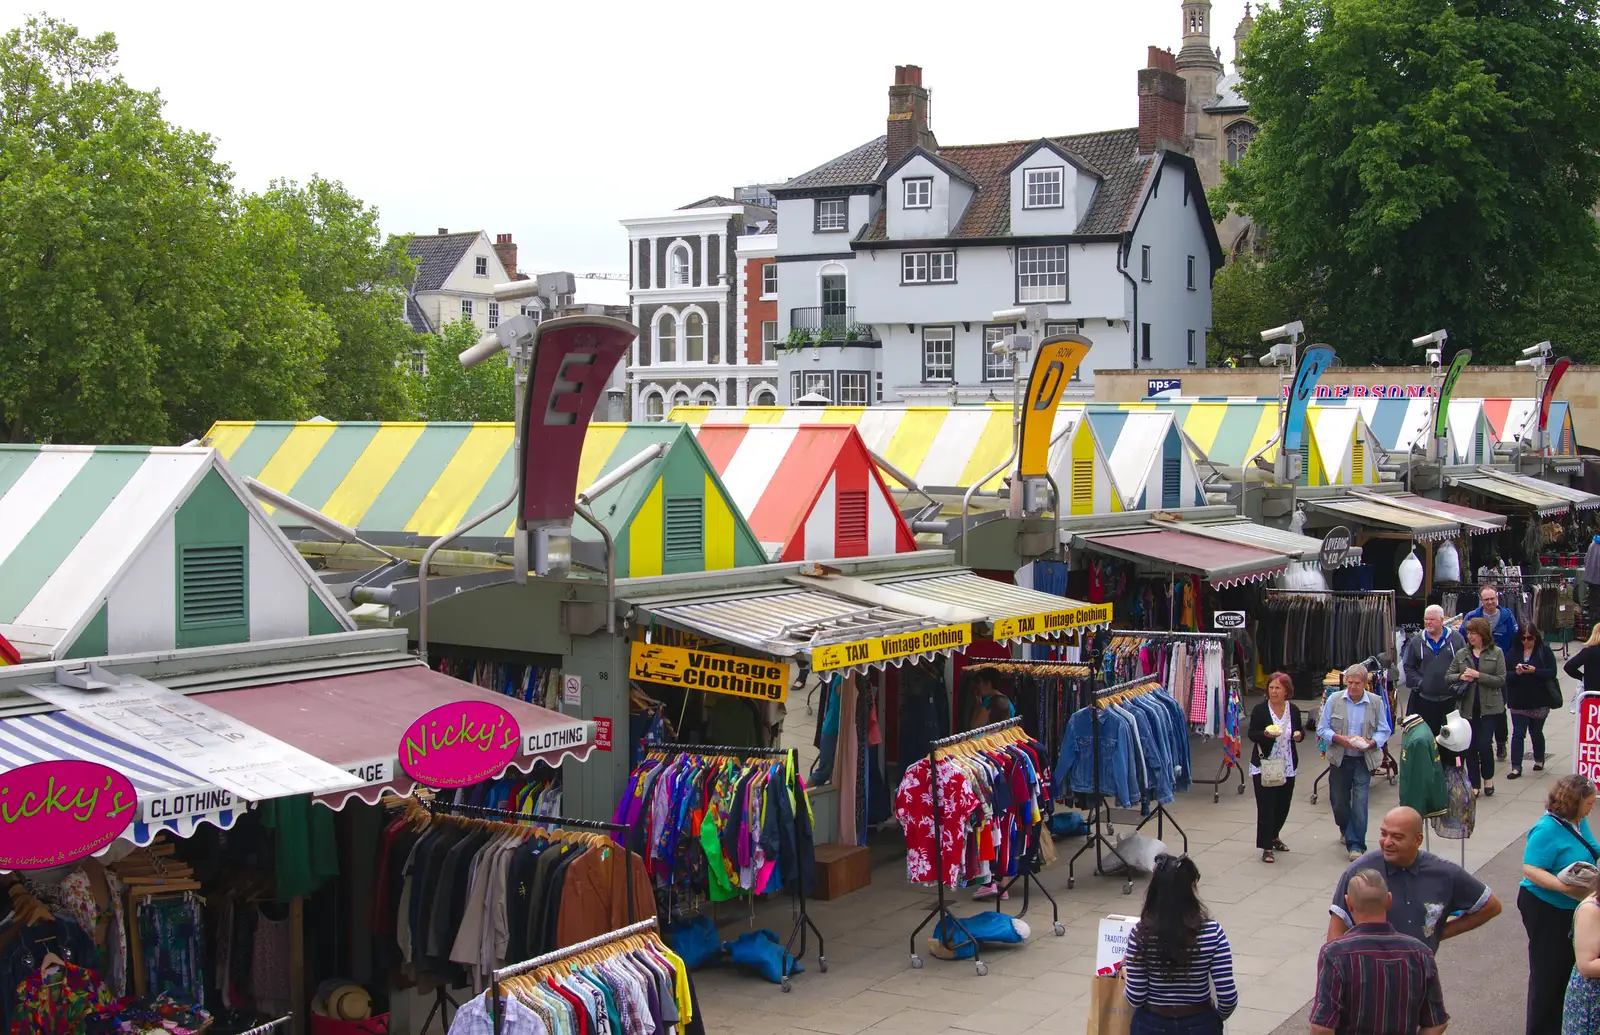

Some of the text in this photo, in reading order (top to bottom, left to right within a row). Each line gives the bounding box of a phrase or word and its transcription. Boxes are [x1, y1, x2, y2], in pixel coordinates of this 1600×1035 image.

[1056, 347, 1075, 358] ROW
[543, 352, 598, 426] E
[1033, 360, 1065, 411] D
[1149, 380, 1170, 392] nps
[1297, 362, 1319, 401] C
[1018, 605, 1107, 632] TAXI Vintage Clothing
[845, 624, 963, 662] TAXI Vintage Clothing
[599, 671, 608, 681] 98
[687, 652, 781, 680] Vintage
[683, 668, 782, 700] Clothing
[406, 713, 519, 766] Nicky's
[528, 726, 584, 752] CLOTHING
[440, 777, 466, 785] clothing
[467, 774, 473, 782] &
[474, 760, 505, 780] accessories
[0, 775, 134, 824] icky's
[151, 788, 232, 818] CLOTHING
[16, 855, 55, 865] clothing
[57, 851, 65, 860] &
[68, 831, 115, 857] accessories
[1104, 934, 1128, 943] TRADITIO
